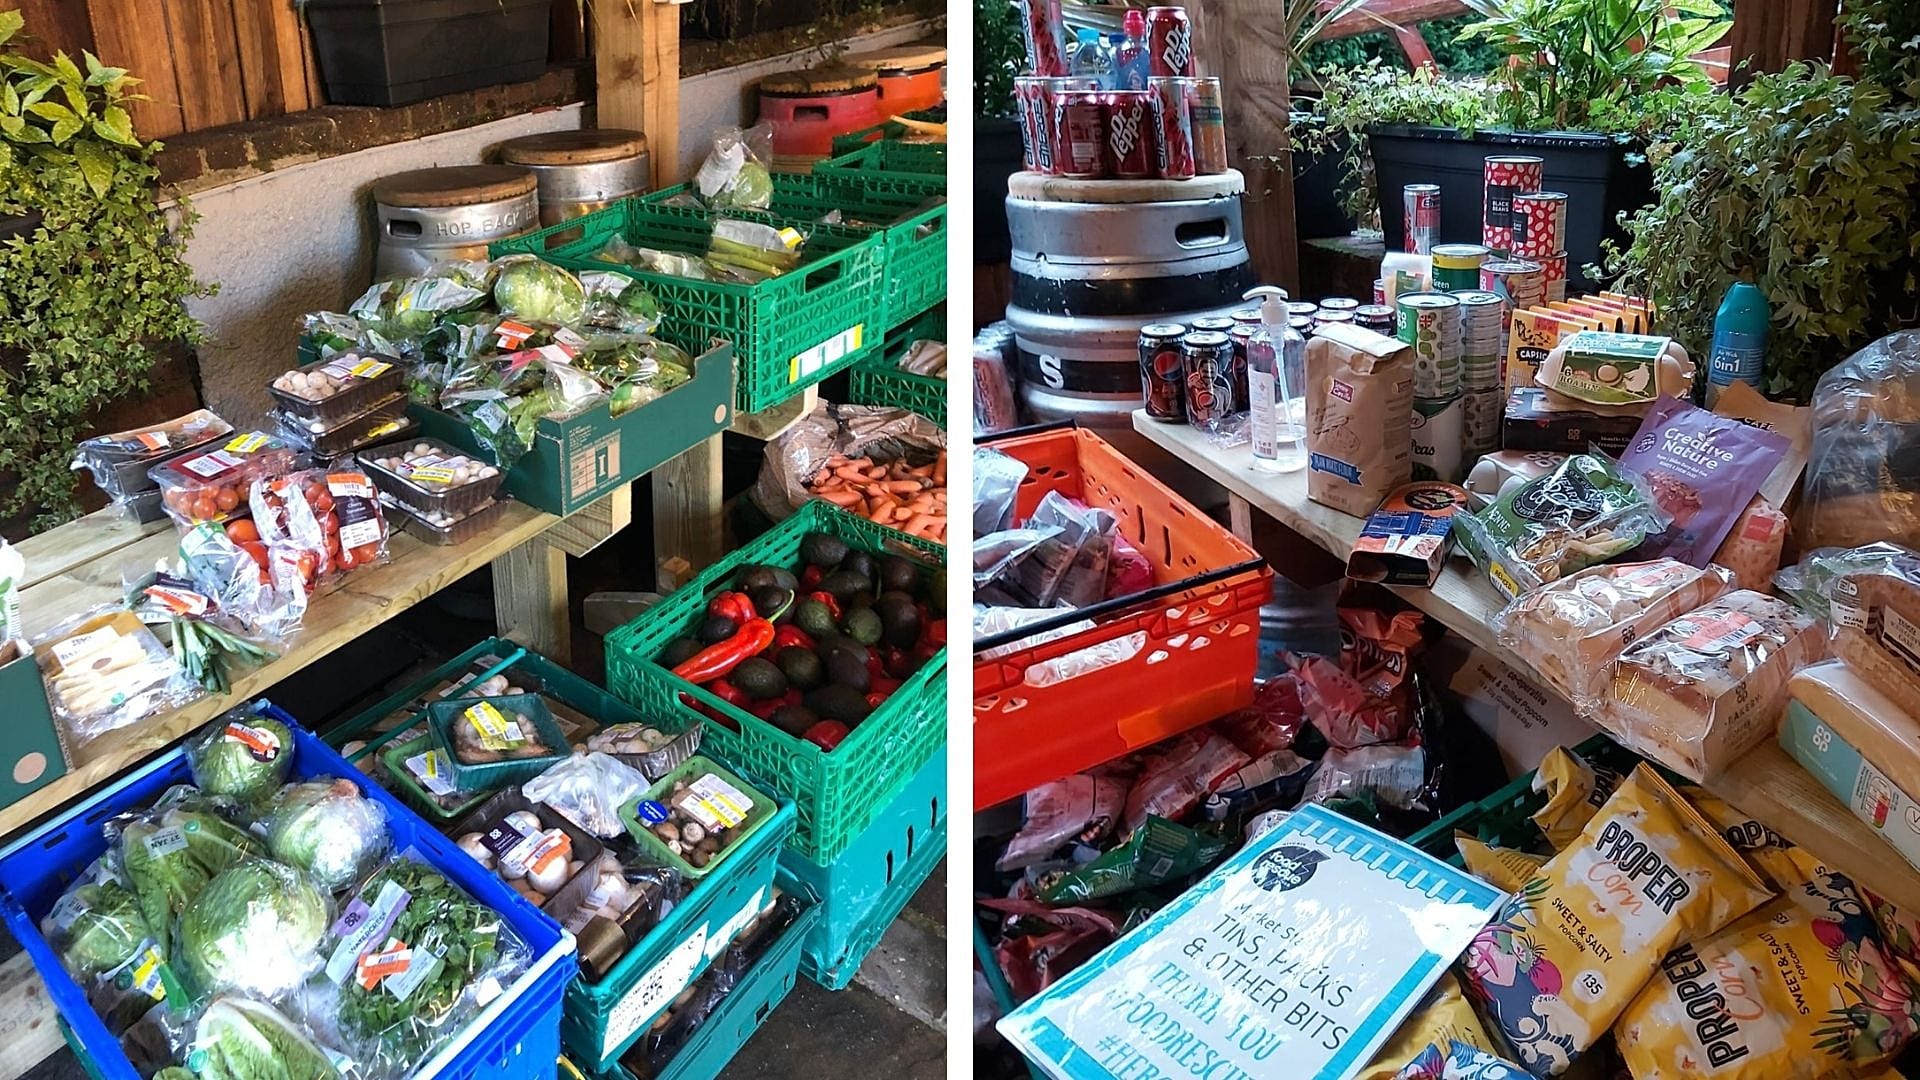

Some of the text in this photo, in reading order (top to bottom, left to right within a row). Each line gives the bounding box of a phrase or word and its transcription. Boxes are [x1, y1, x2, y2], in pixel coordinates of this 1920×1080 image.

[1165, 25, 1183, 49] Dr
[1033, 100, 1050, 169] EMERGE
[1110, 98, 1144, 163] Pepper
[1111, 110, 1127, 139] Dr
[436, 222, 472, 237] HOP
[482, 211, 520, 233] BACK
[1039, 354, 1065, 389] S
[1520, 349, 1550, 361] CAPSIC
[1564, 366, 1573, 378] 6
[1714, 355, 1741, 373] 6in1
[1661, 439, 1719, 471] Nature
[1664, 427, 1735, 463] Creative
[1520, 700, 1549, 728] Popcorn
[1260, 859, 1302, 884] rescue
[1270, 850, 1303, 871] food
[1594, 820, 1691, 916] PROPER
[1588, 859, 1644, 918] Corn
[1551, 897, 1614, 964] SWEET & SALTY
[1558, 923, 1586, 953] POPCORN
[1212, 913, 1353, 1008] TINS, PACKS
[1777, 956, 1789, 968] &
[1783, 942, 1809, 981] POPCORN
[1183, 937, 1350, 1051] & OTHER BITS
[1582, 973, 1603, 995] 135
[1710, 953, 1765, 1022] Corn
[1781, 969, 1811, 1016] SWEET
[1149, 960, 1283, 1061] THANK YOU
[1660, 941, 1750, 1069] PROPER
